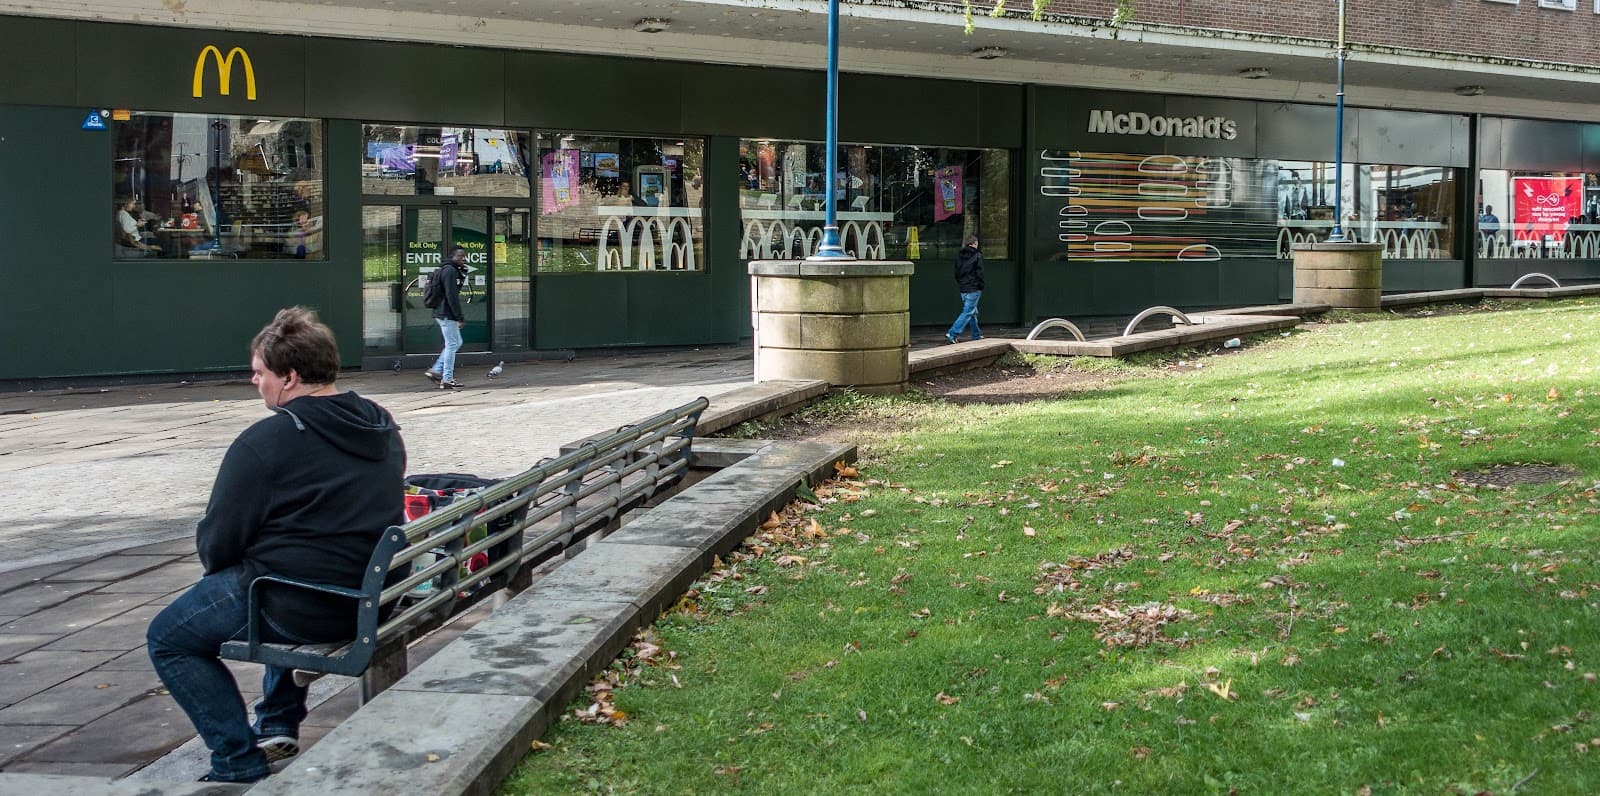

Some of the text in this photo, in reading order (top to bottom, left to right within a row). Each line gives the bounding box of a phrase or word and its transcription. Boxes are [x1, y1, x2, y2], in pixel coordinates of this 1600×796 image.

[192, 44, 257, 101] M
[1087, 108, 1238, 141] McDonald's
[423, 242, 437, 250] Only
[469, 242, 485, 250] Only
[406, 252, 488, 263] ENTRNCE
